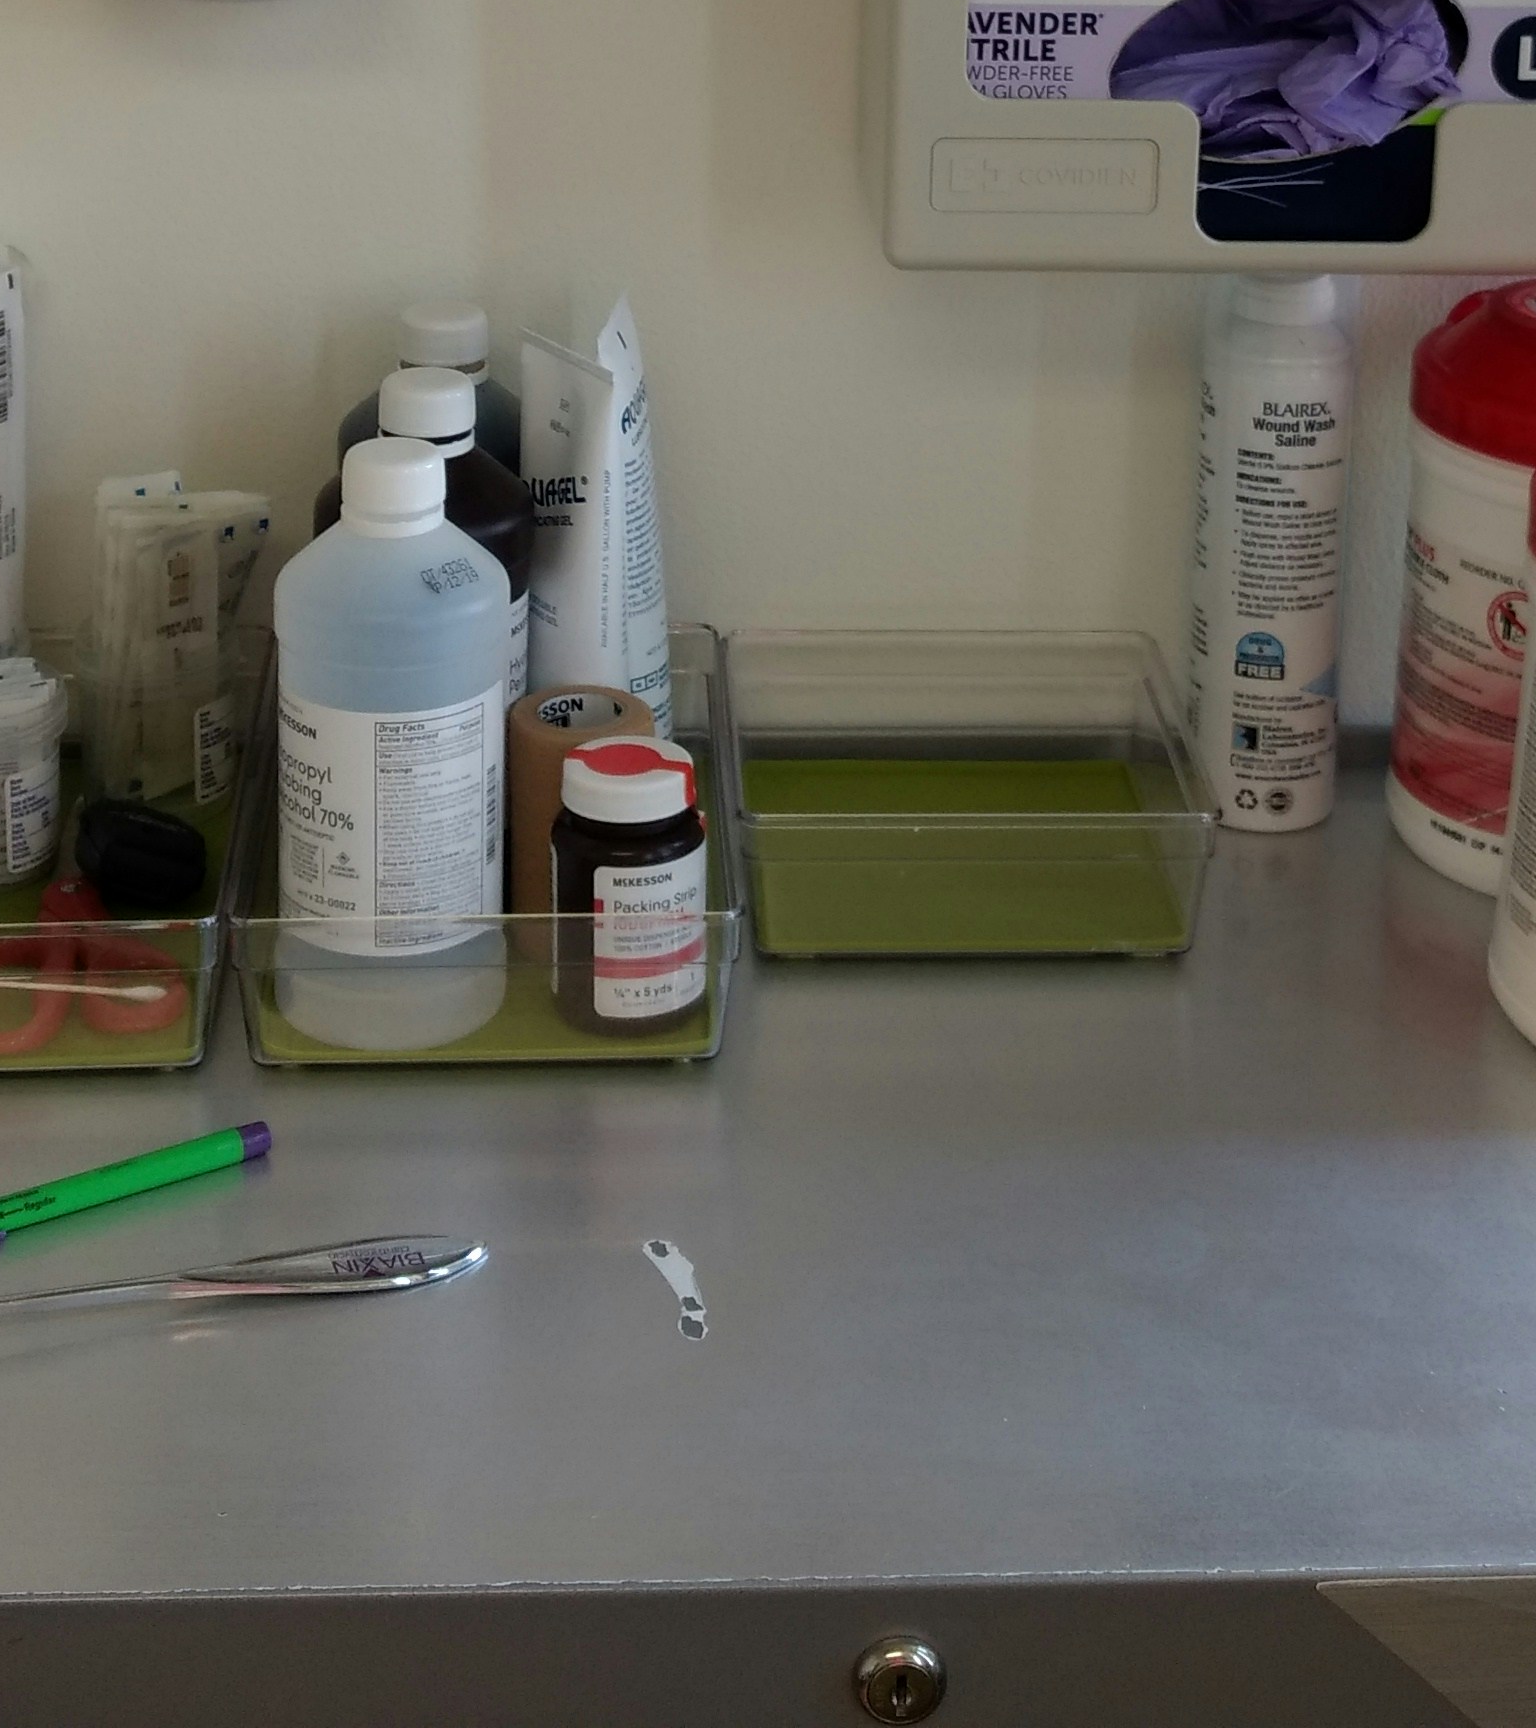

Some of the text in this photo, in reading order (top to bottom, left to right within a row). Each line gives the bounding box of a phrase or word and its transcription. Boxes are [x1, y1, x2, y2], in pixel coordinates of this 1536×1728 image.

[992, 85, 1068, 100] GLOVES
[1262, 401, 1328, 418] BLAIREX
[1252, 417, 1336, 433] Wound Wash
[1274, 434, 1317, 447] Saline
[1237, 662, 1283, 679] FREE
[378, 722, 426, 734] Drug Facts
[378, 735, 401, 745] Active
[378, 751, 393, 760] Use
[378, 766, 413, 774] Warnings
[320, 807, 355, 832] 70%
[614, 886, 698, 914] Packing Strip
[643, 986, 653, 997] 5
[653, 983, 673, 997] yds
[331, 1250, 426, 1275] BIAXIN
